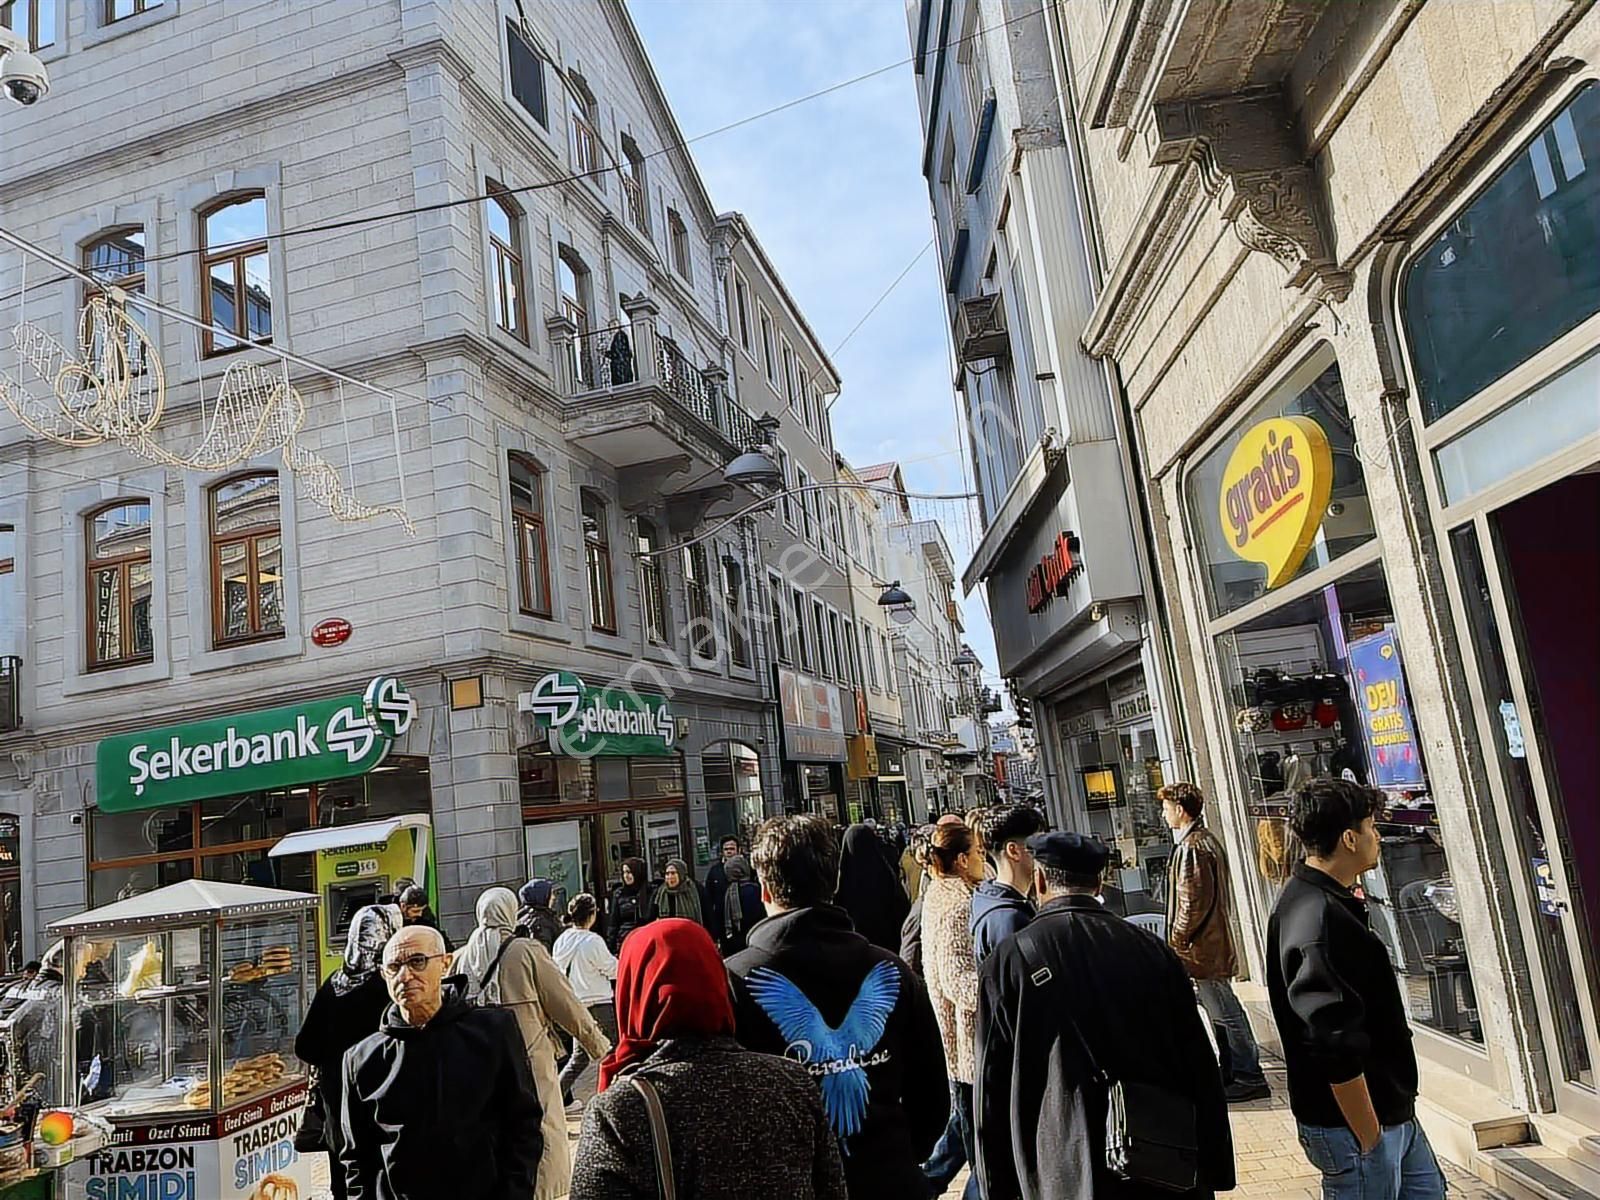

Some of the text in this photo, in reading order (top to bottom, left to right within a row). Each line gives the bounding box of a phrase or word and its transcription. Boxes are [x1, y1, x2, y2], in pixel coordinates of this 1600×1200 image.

[1226, 429, 1301, 547] gratis
[1366, 680, 1397, 711] DEV
[129, 716, 321, 796] Şekerbank
[784, 1040, 893, 1076] Paradise
[177, 1122, 212, 1139] Simit
[224, 1113, 243, 1132] Özel
[242, 1105, 264, 1125] Simit
[232, 1112, 298, 1158] TRABZON
[86, 1146, 195, 1176] TRABZON
